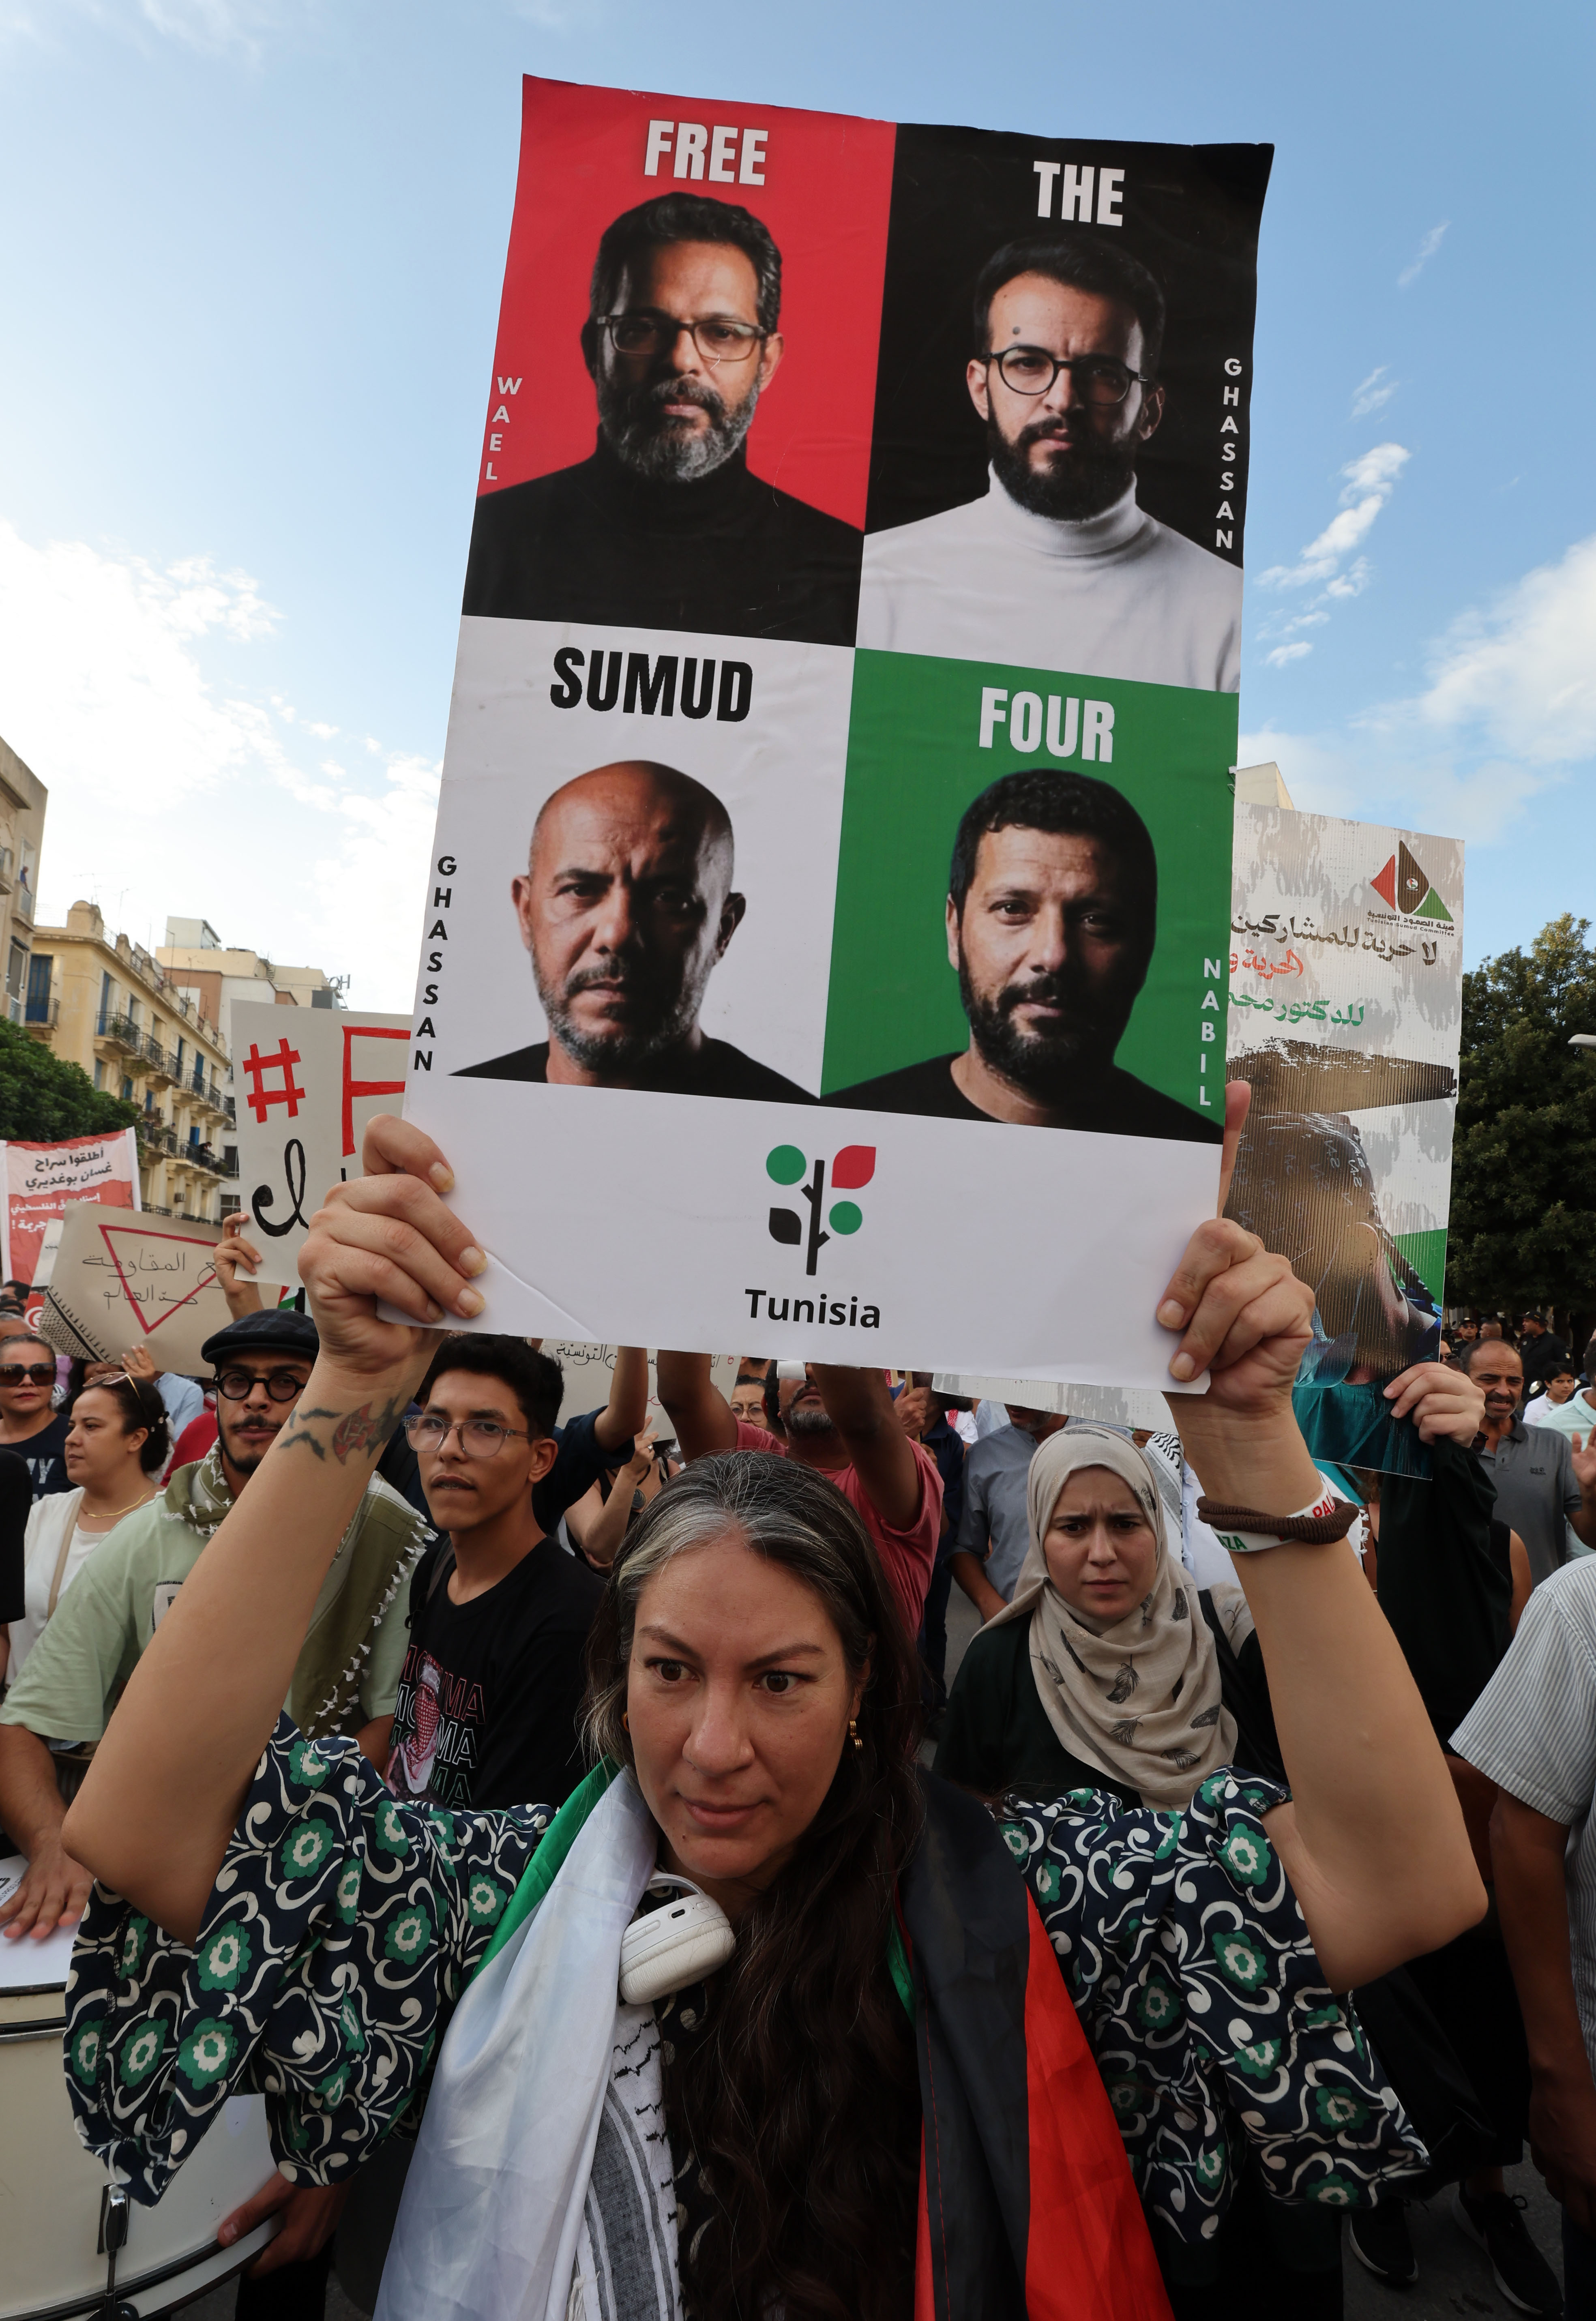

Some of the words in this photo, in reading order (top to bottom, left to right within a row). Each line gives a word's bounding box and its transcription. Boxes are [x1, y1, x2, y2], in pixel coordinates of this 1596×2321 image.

[645, 120, 768, 185] FREE
[1034, 161, 1124, 226] THE
[486, 377, 522, 480] WAEL
[1216, 358, 1241, 549] GHASSAN
[550, 647, 753, 722] SUMUD
[979, 687, 1115, 762] FOUR
[1231, 915, 1359, 948] للمشاركين
[1367, 910, 1400, 921] التونسية
[1367, 917, 1393, 926] Tunisian
[1420, 927, 1454, 937] Committee
[1403, 917, 1433, 927] الصمود
[414, 856, 457, 1070] GHASSAN
[1362, 931, 1417, 962] حرية
[1422, 941, 1437, 966] لا
[1273, 1000, 1364, 1026] للدكتور
[1200, 958, 1221, 1105] NABIL
[35, 1158, 66, 1171] سراح
[81, 1162, 112, 1182] غسان
[26, 1173, 77, 1191] بوغديري
[745, 1289, 880, 1328] Tunisia
